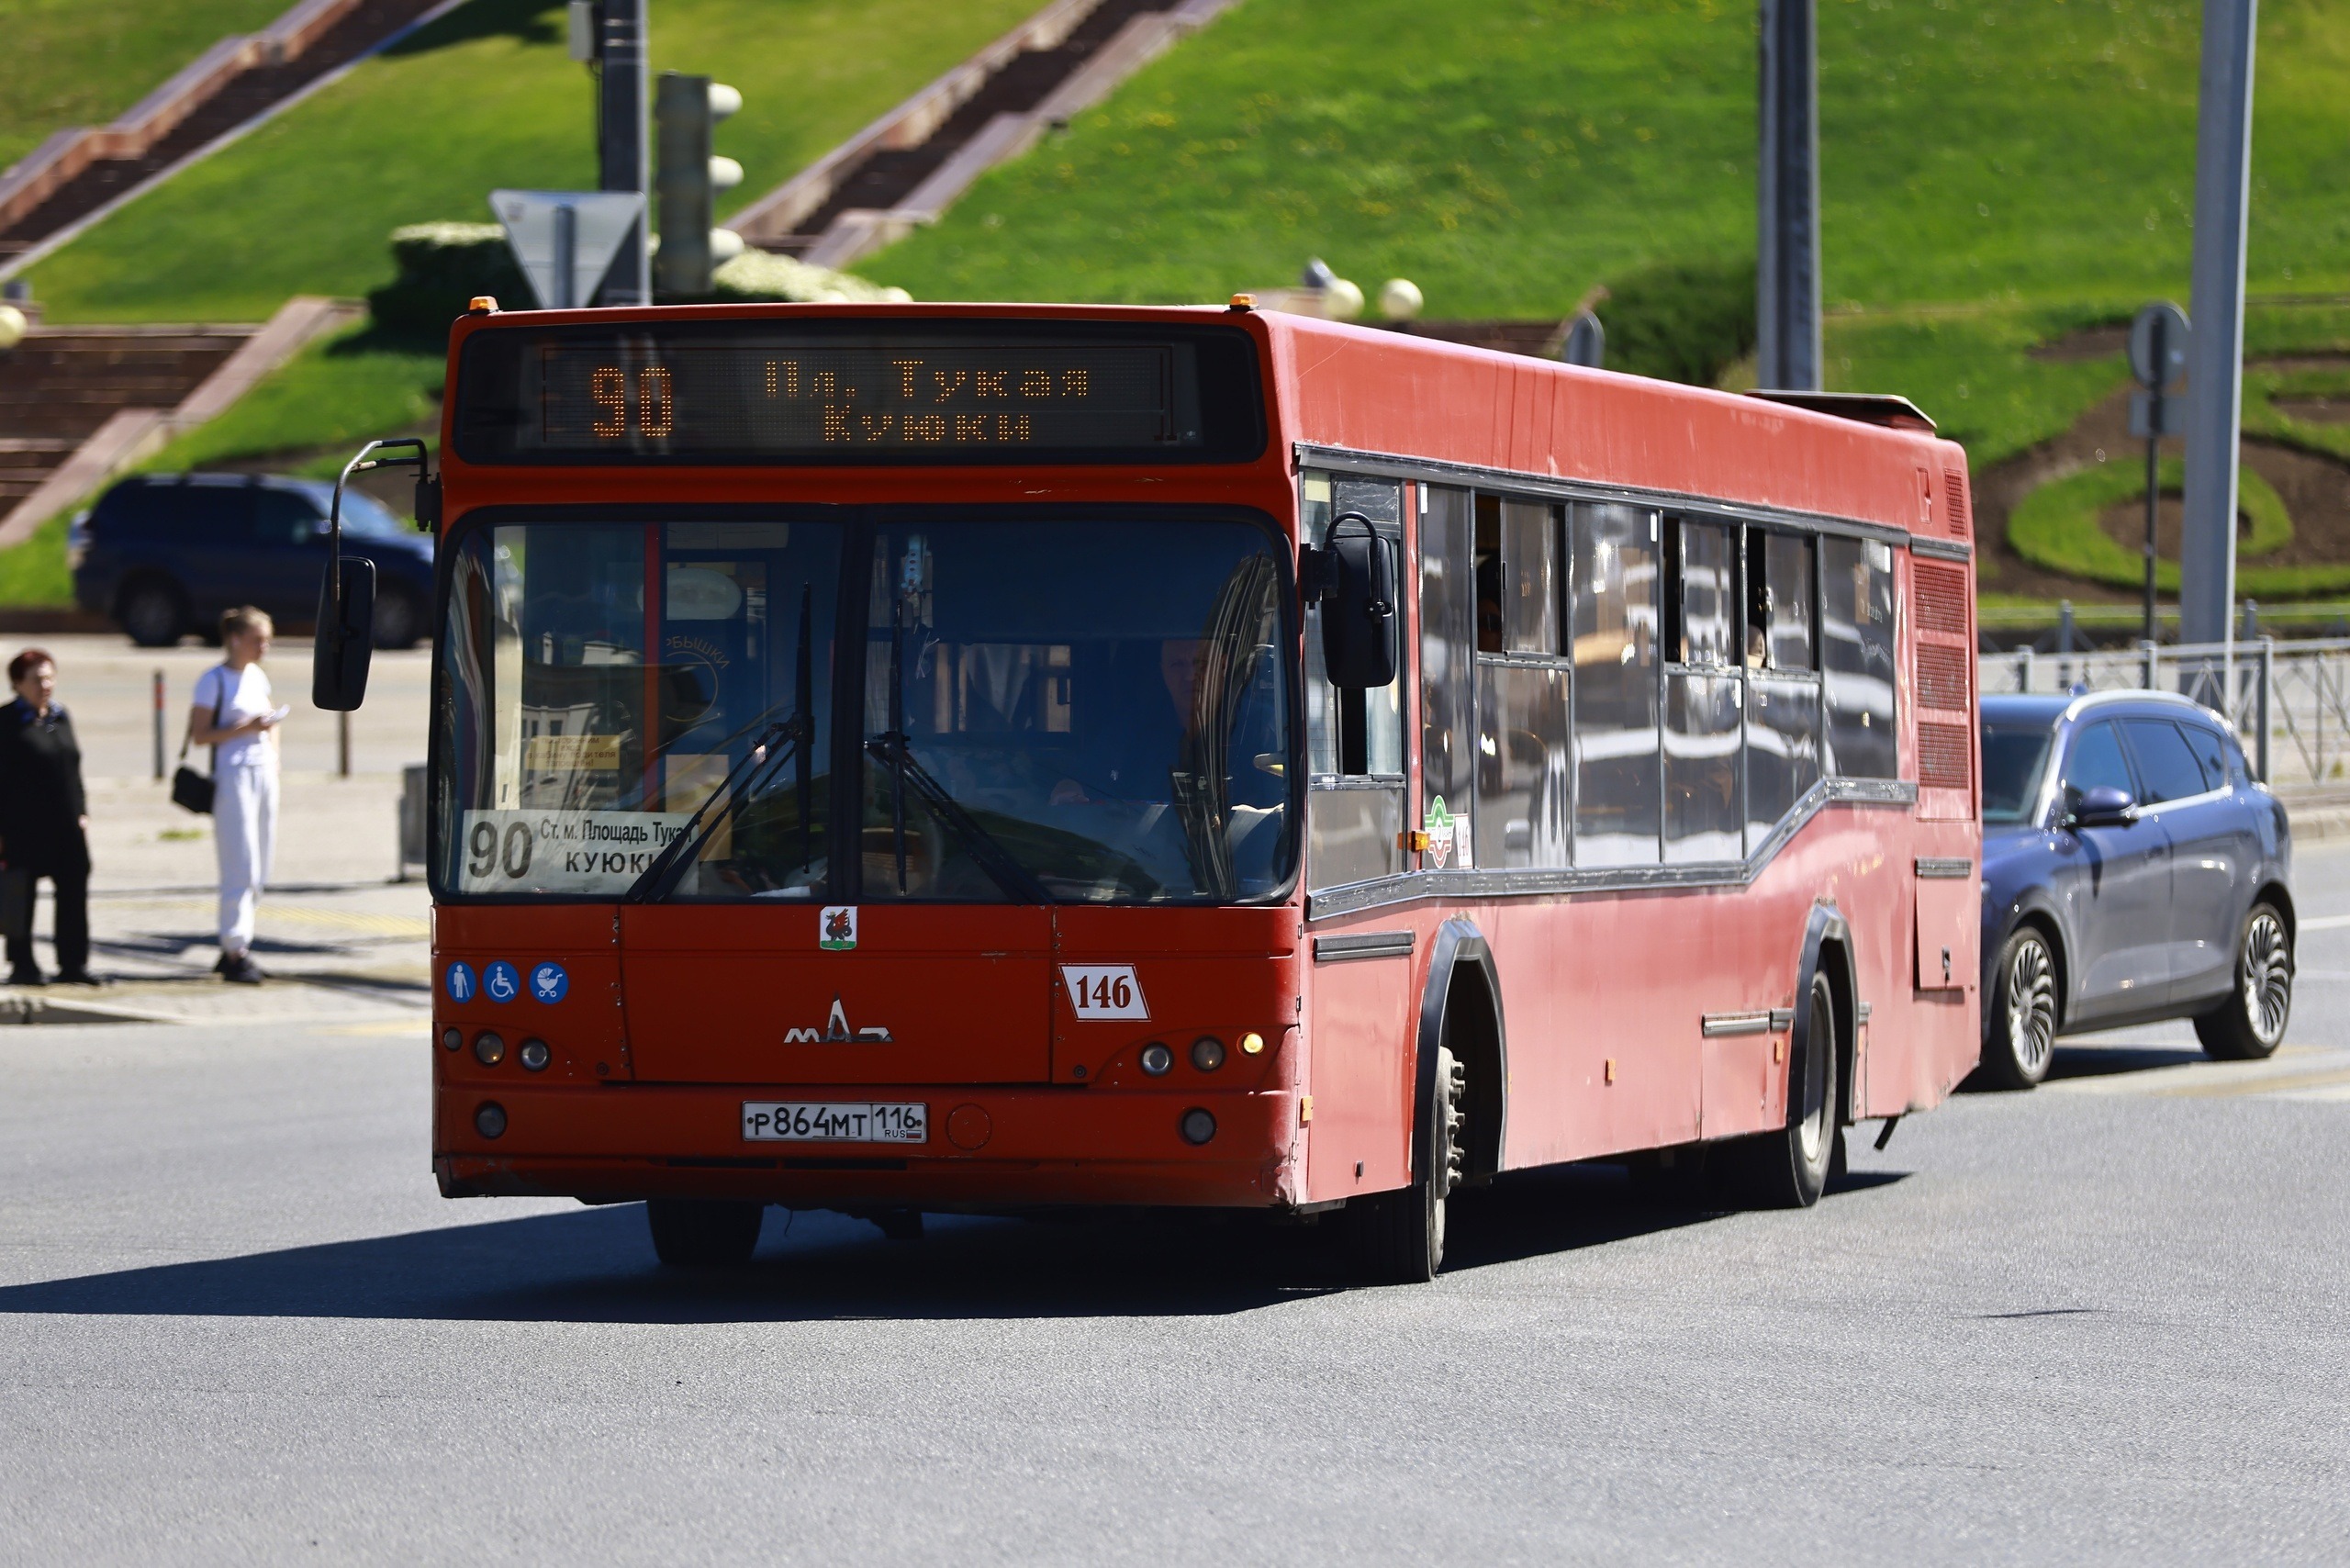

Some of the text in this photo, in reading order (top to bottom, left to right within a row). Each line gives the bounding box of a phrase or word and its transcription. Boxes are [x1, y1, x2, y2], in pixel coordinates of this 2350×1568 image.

[766, 360, 1087, 402] Пл. Тукая
[593, 368, 671, 437] 90
[824, 404, 1030, 441] Куюки
[540, 818, 559, 840] Ст.
[564, 824, 577, 840] м.
[582, 819, 648, 845] Площадь
[468, 821, 532, 879] 90
[1076, 975, 1132, 1009] 146
[875, 1106, 918, 1130] 116
[884, 1129, 906, 1138] RUS
